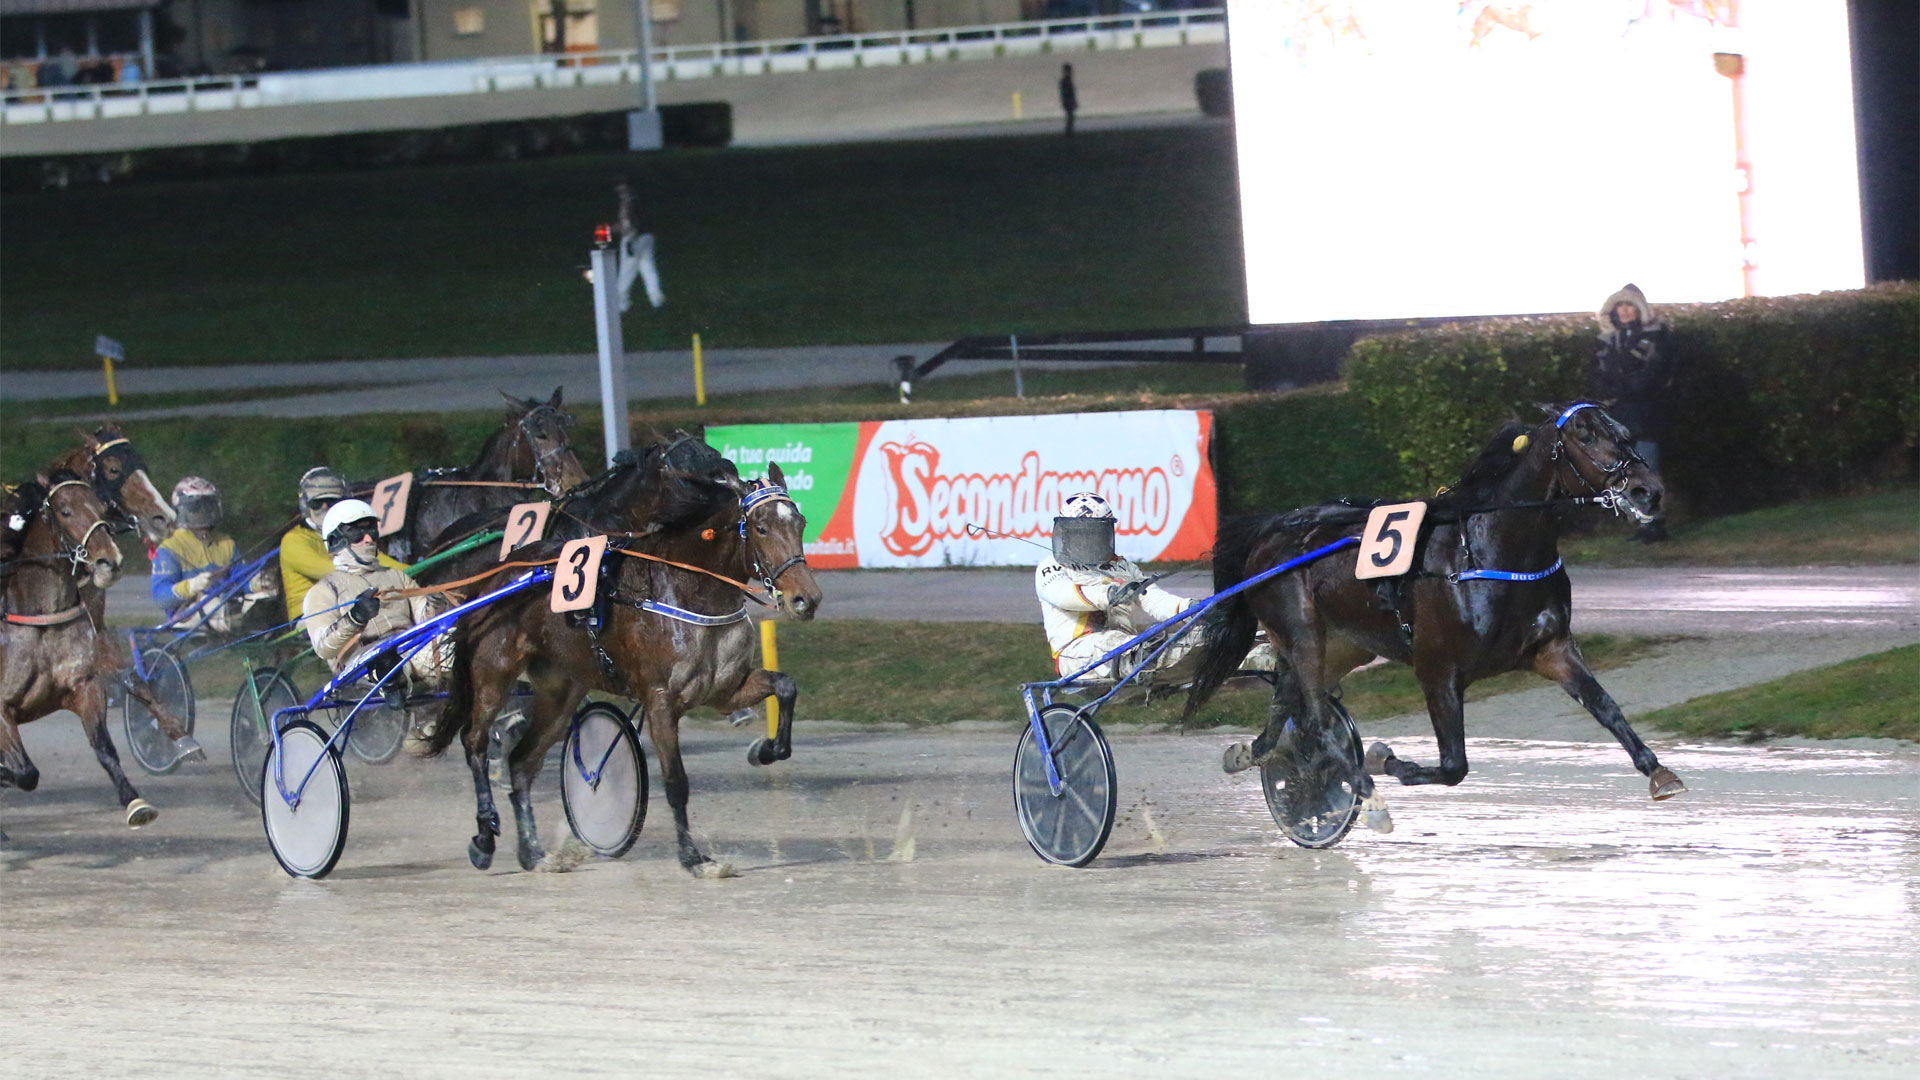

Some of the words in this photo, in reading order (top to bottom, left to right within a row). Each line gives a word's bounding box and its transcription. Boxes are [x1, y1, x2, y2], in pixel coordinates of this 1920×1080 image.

[740, 445, 764, 464] tua
[766, 441, 813, 467] guida
[380, 480, 404, 529] 7
[511, 509, 538, 551] 2
[1371, 510, 1410, 568] 5
[562, 544, 591, 602] 3
